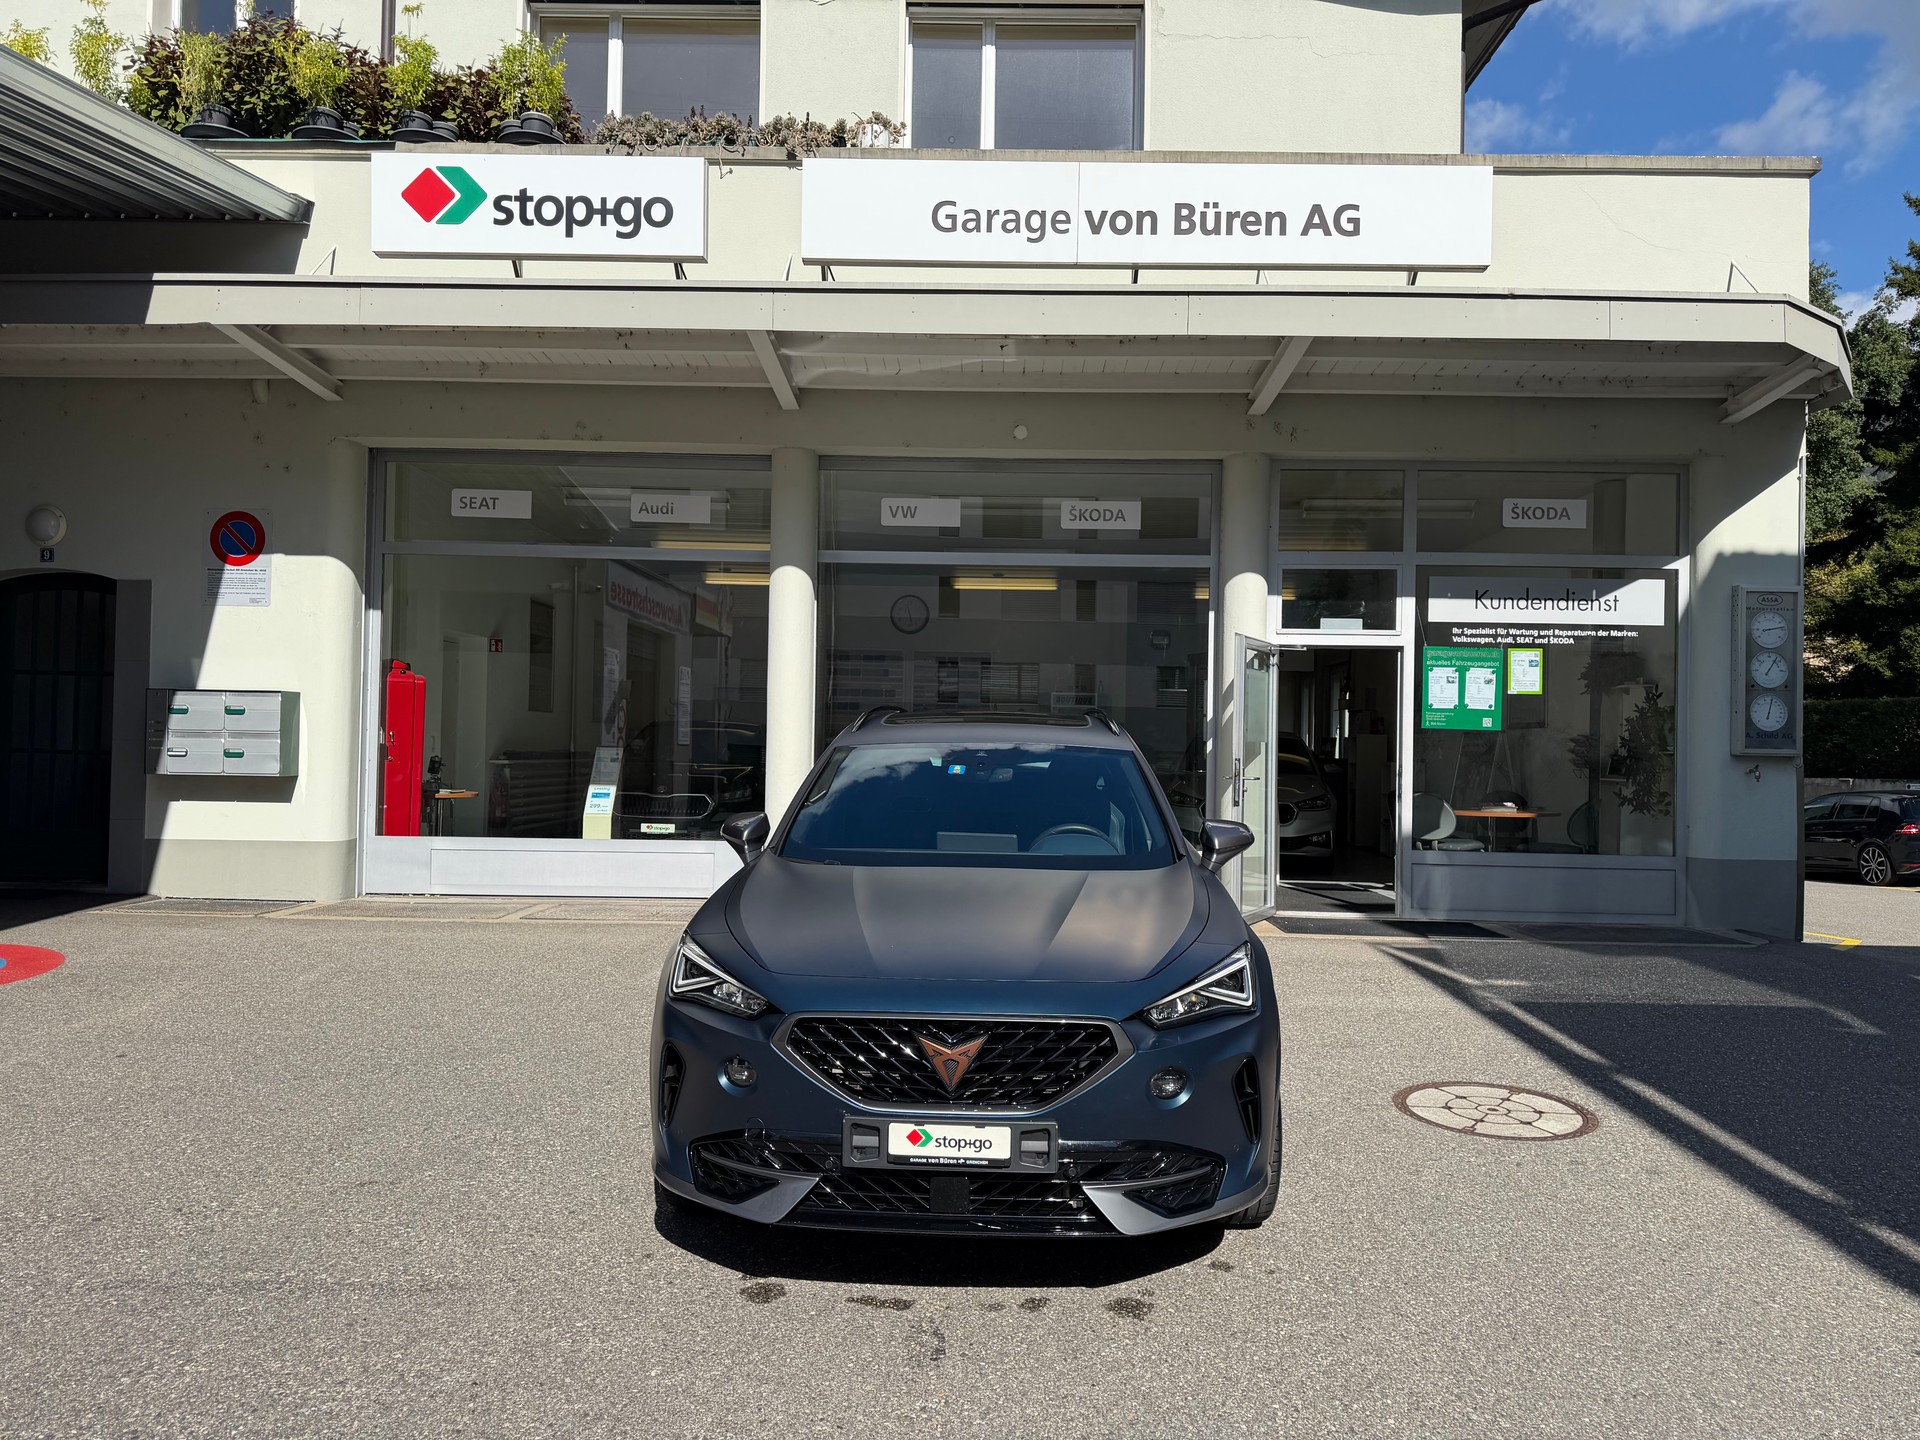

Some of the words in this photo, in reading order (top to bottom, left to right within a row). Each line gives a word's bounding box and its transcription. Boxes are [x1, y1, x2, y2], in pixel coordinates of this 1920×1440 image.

[492, 187, 674, 240] stop+go
[931, 200, 1072, 244] Garage
[1084, 209, 1158, 236] von
[1173, 202, 1287, 236] Büren
[1300, 203, 1361, 237] AG
[459, 496, 499, 510] SEAT
[638, 502, 674, 515] Audi
[888, 505, 918, 519] VW
[1068, 505, 1127, 522] ŠKODA
[1511, 502, 1571, 520] ŠKODA
[43, 550, 50, 560] 9
[1474, 587, 1620, 612] Kundendienst
[1452, 627, 1462, 635] Ihr
[1463, 627, 1496, 636] Spezialist
[1497, 627, 1507, 635] für
[1508, 628, 1539, 637] Wartung
[1539, 628, 1554, 636] und
[1597, 629, 1610, 637] der
[1452, 636, 1496, 645] Volkswagen,
[1496, 636, 1515, 644] Audi,
[1549, 636, 1575, 645] ŠKODA
[1452, 659, 1500, 667] Fahrzeugangebot
[1755, 731, 1779, 739] Schild
[935, 1136, 993, 1152] stop+go
